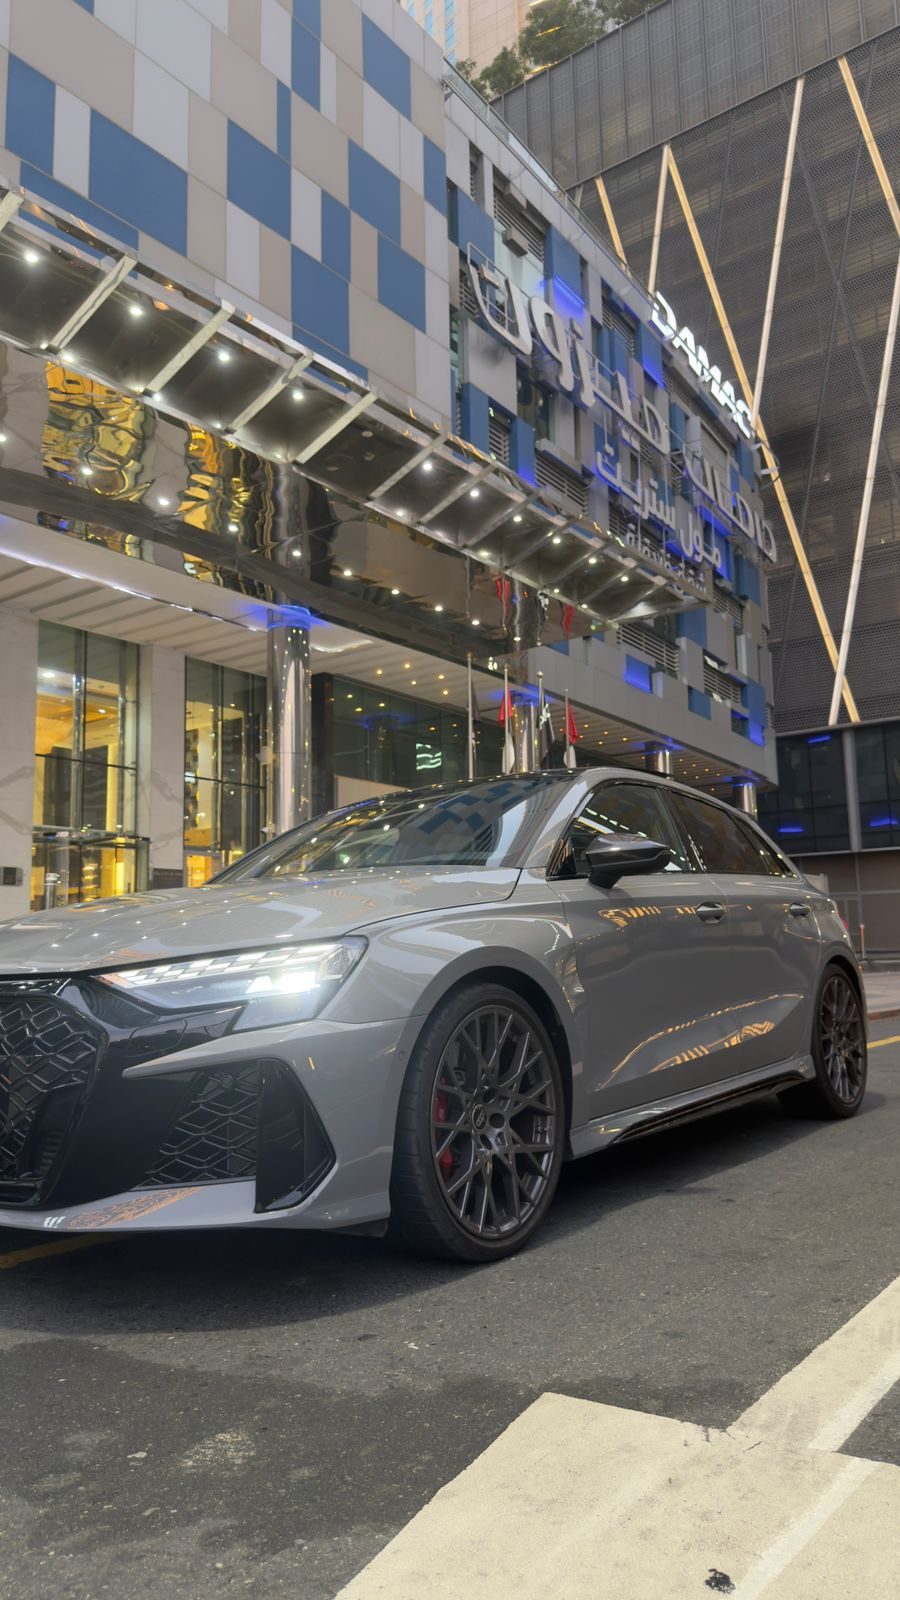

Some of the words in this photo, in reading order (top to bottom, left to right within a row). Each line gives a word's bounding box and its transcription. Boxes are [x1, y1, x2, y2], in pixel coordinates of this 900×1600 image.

[467, 262, 670, 455] ميزون
[651, 291, 753, 439] DAMAC
[596, 444, 675, 532] ستريت
[679, 512, 721, 569] مول
